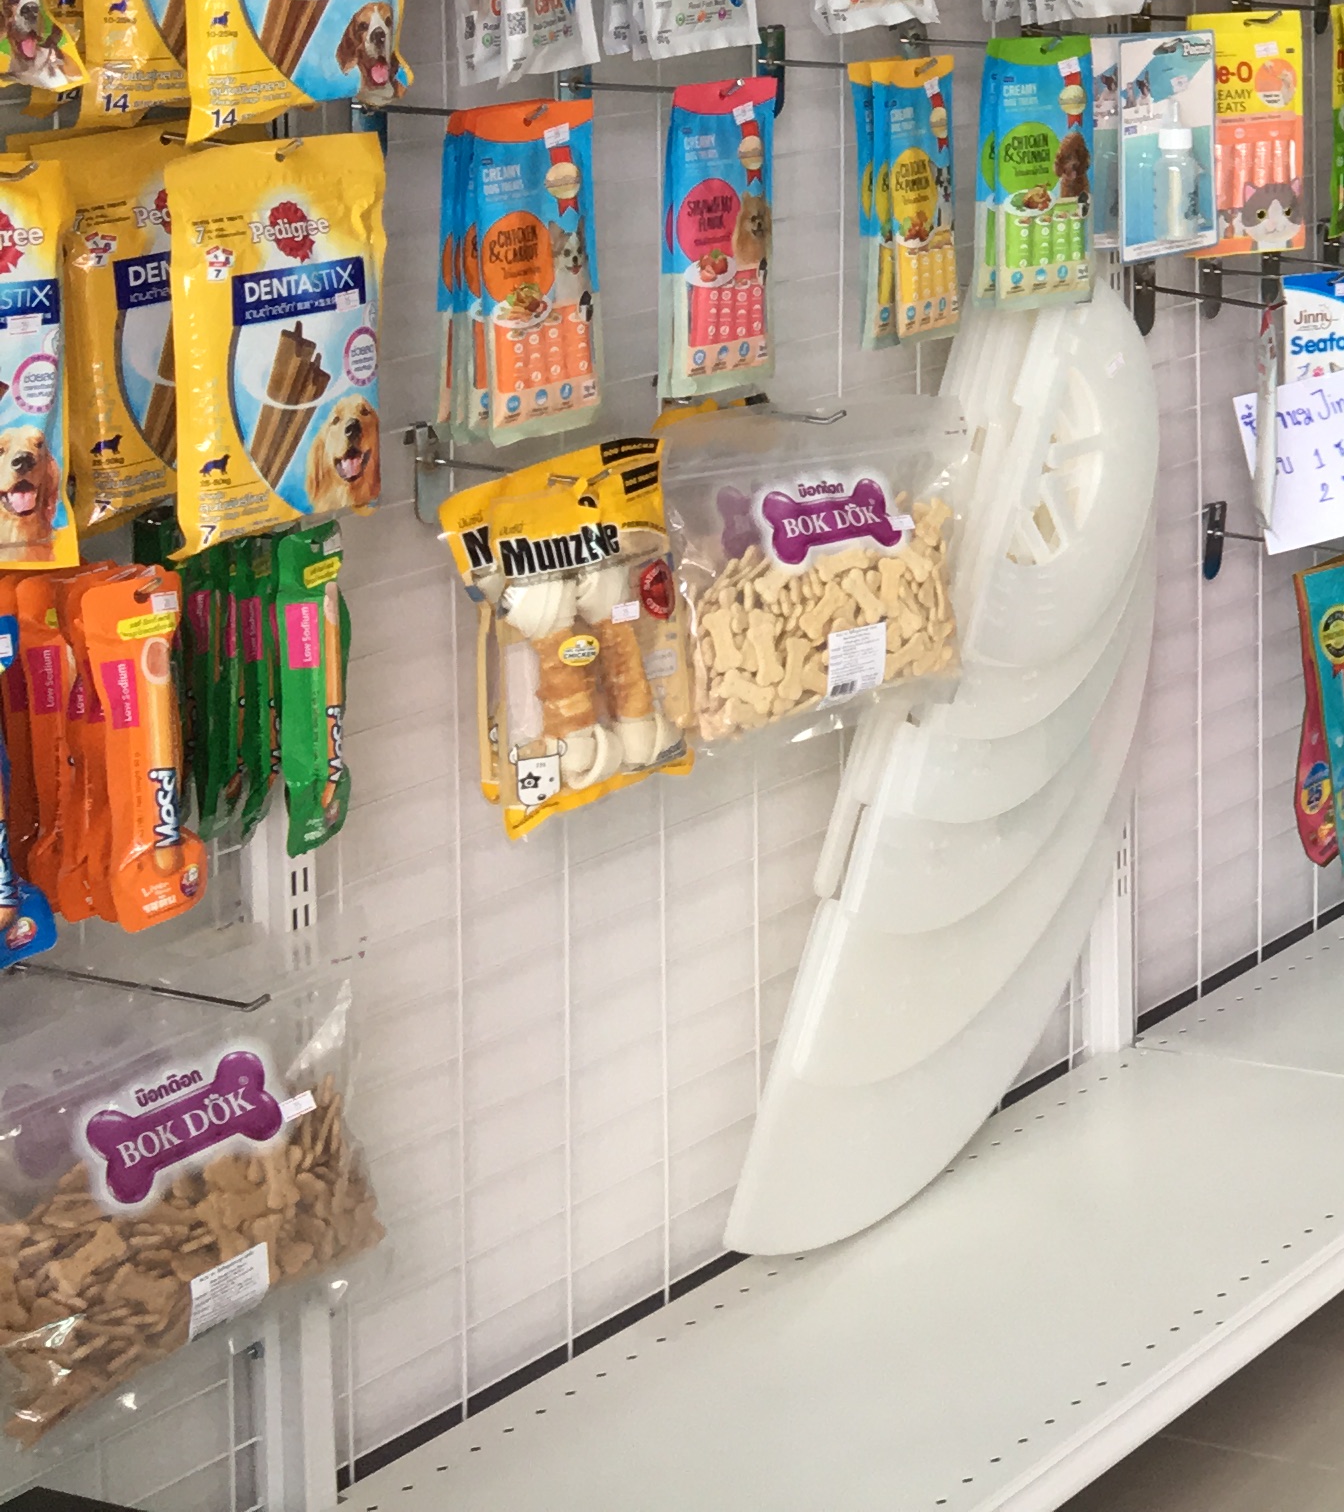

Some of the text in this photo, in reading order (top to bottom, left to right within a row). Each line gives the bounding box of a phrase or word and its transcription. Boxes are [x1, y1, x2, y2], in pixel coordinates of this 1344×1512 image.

[102, 94, 129, 112] 14
[211, 109, 237, 127] 14
[249, 218, 330, 241] Pedigree
[245, 264, 355, 302] DENTASTIX
[1294, 310, 1332, 329] Jinny
[1319, 482, 1334, 502] 2
[200, 524, 216, 543] 7
[783, 512, 829, 538] BOK
[302, 605, 312, 663] Low Sodium
[43, 649, 55, 708] Low Sodium
[117, 663, 133, 723] Low Sodium
[116, 1122, 183, 1168] BOK
